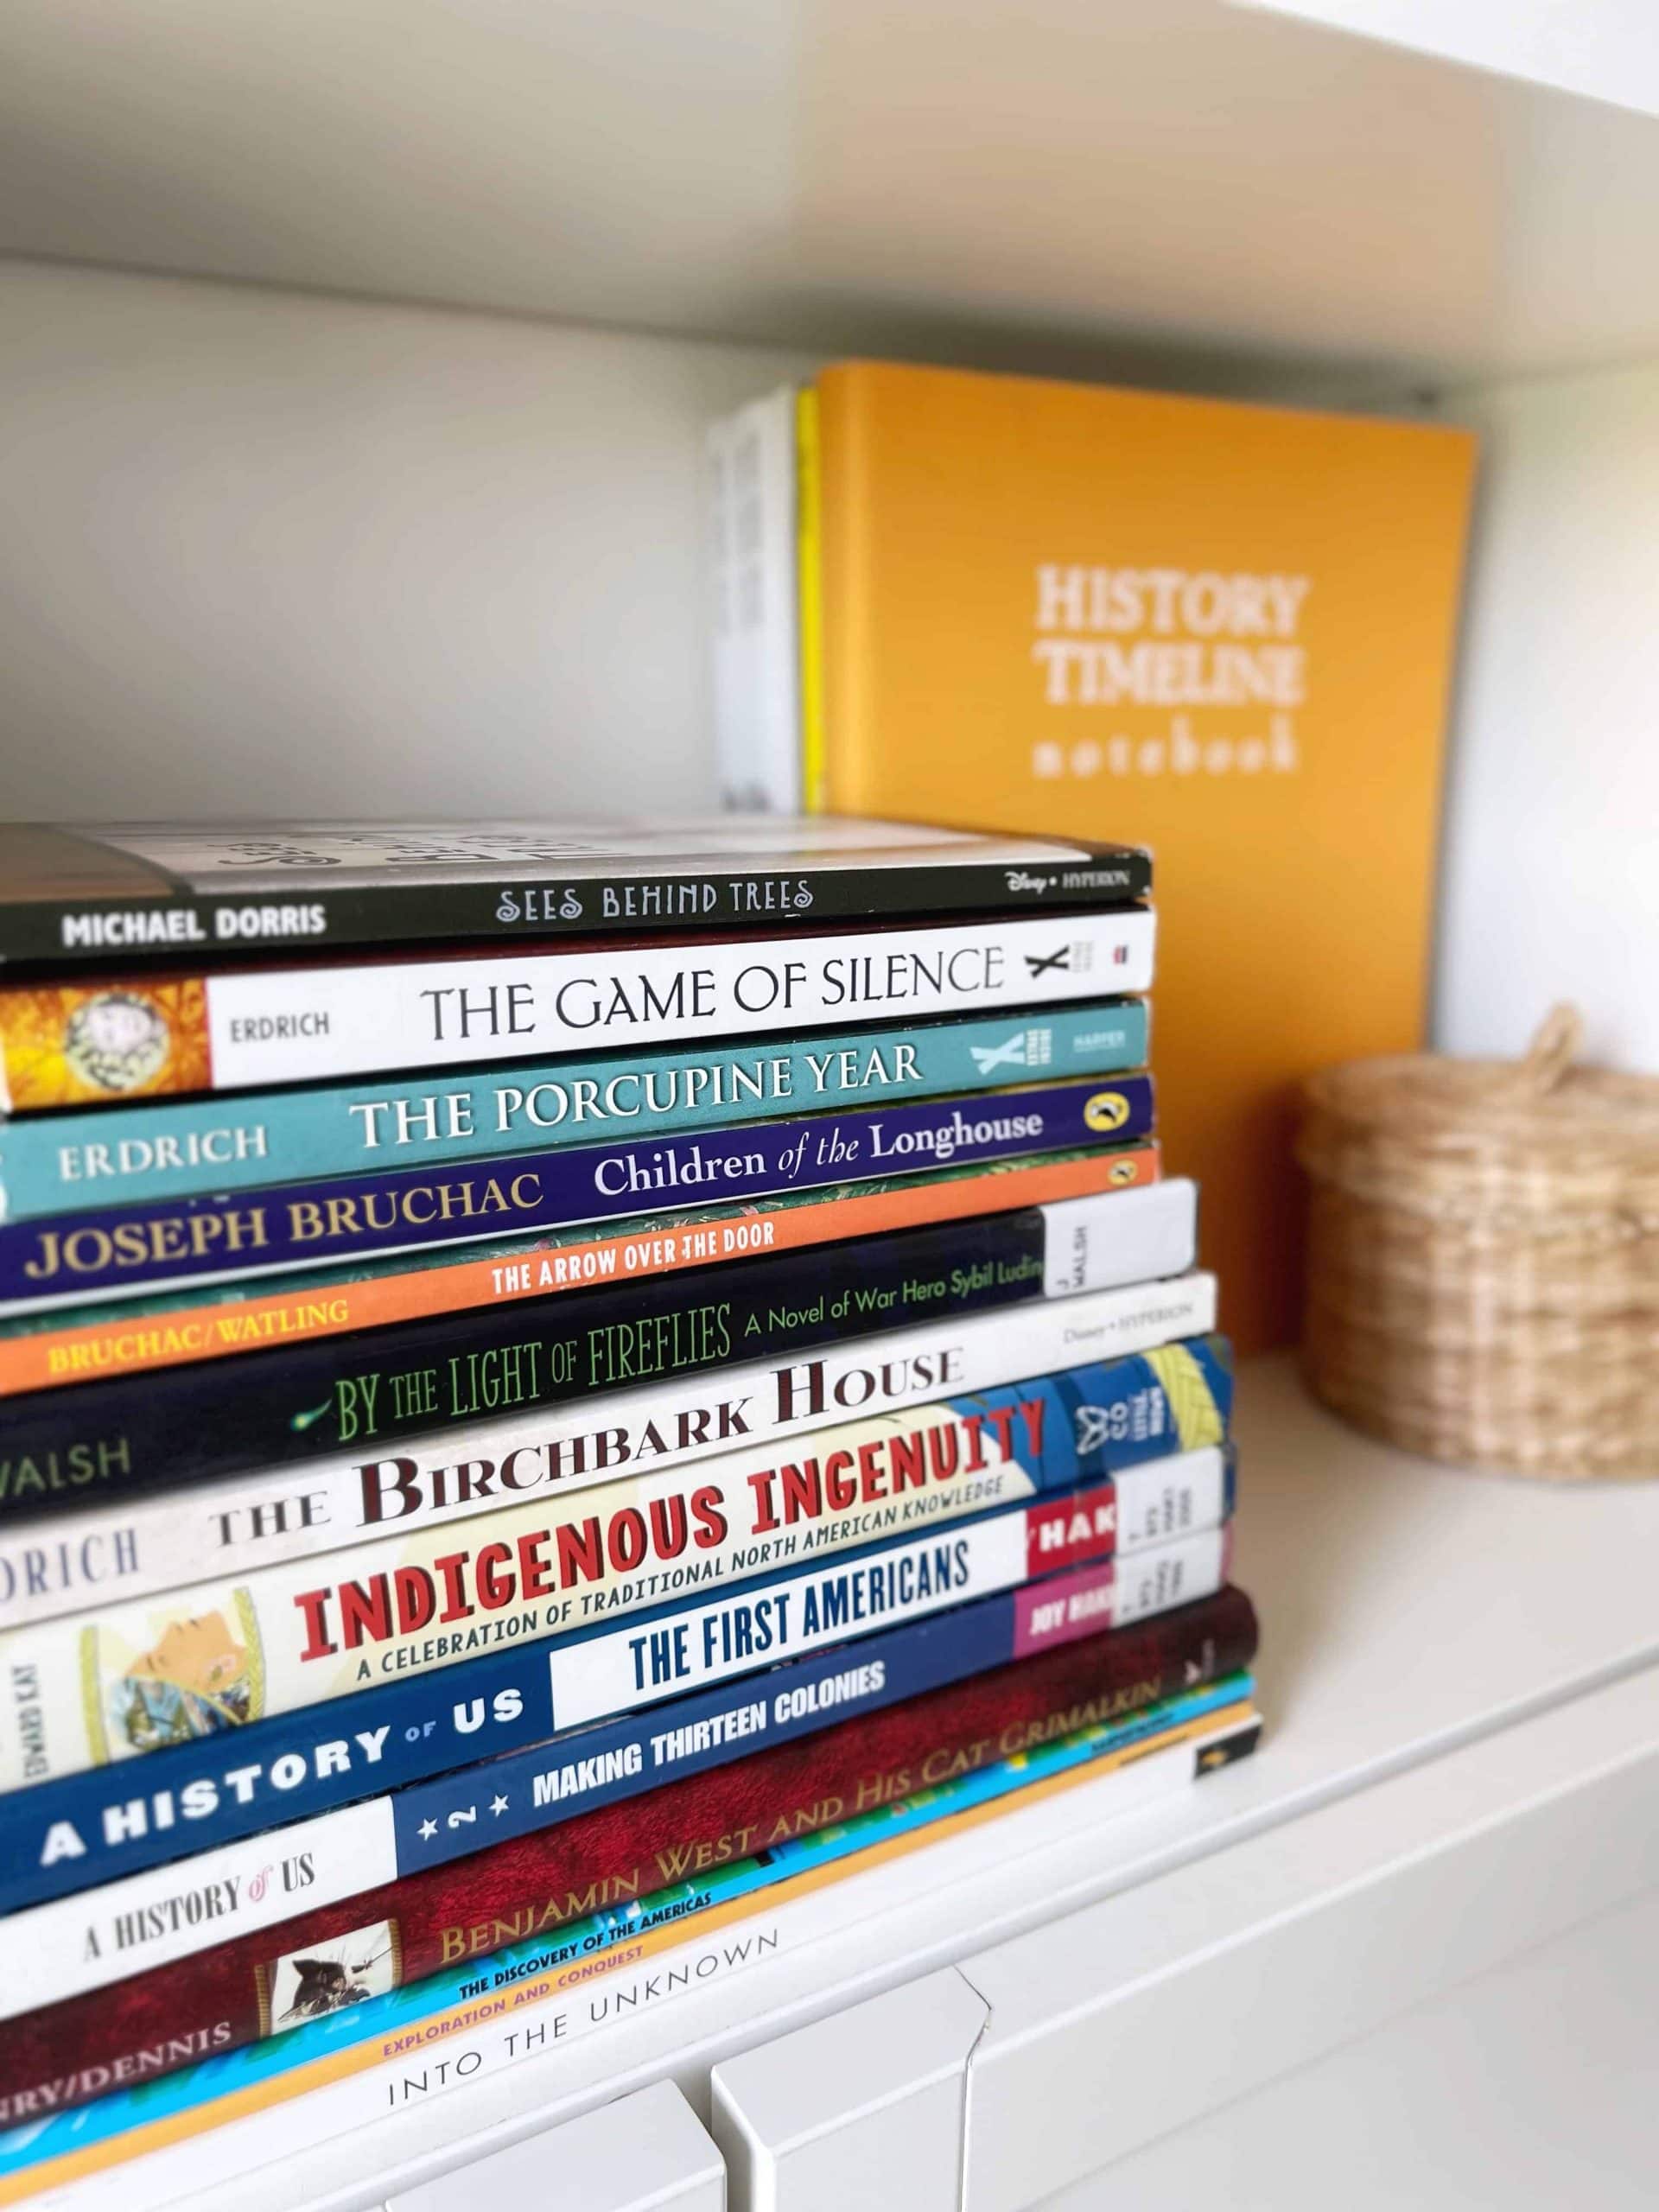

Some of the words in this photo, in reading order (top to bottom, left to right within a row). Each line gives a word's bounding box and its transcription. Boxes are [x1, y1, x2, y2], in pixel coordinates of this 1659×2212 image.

[1036, 563, 1313, 638] HISTORY
[1032, 640, 1308, 706] TIMELINE
[1032, 714, 1296, 779] notebook
[62, 911, 206, 947] MICHAEL
[216, 905, 327, 940] DORRIS
[496, 887, 582, 923] SEES
[602, 883, 717, 918] BEHIND
[730, 878, 814, 912] TREES
[230, 1011, 330, 1043] ERDRICH
[419, 982, 536, 1041] THE
[556, 969, 715, 1029] GAME
[734, 963, 809, 1013] OF
[823, 945, 1005, 1005] SILENCE
[348, 1092, 474, 1149] THE
[493, 1057, 792, 1133] PORCUPINE
[804, 1043, 925, 1094] YEAR
[58, 1124, 268, 1183] ERDRICH
[594, 1147, 766, 1196] Children
[779, 1133, 808, 1179] of
[816, 1126, 860, 1166] the
[868, 1111, 1043, 1159] Longhouse
[24, 1208, 268, 1281] JOSEPH
[287, 1173, 543, 1243] BRUCHAC
[493, 1268, 532, 1294] THE
[539, 1247, 616, 1286] ARROW
[624, 1235, 677, 1267] OVER
[682, 1231, 717, 1261] THE
[723, 1221, 775, 1252] DOOR
[48, 1300, 349, 1375] BRUCHAC/WATLING
[744, 1312, 763, 1338] A
[768, 1304, 825, 1332] Novel
[831, 1296, 852, 1319] of
[855, 1288, 898, 1313] War
[903, 1279, 945, 1303] Hero
[951, 1262, 994, 1297] Sybil
[336, 1373, 380, 1442] BY
[394, 1370, 437, 1419] THE
[448, 1341, 542, 1416] LIGHT
[551, 1340, 577, 1384] OF
[587, 1302, 732, 1389] FIREFLIES
[209, 1490, 333, 1548] THE
[352, 1395, 753, 1528] BIRCHBARK
[769, 1345, 965, 1424] HOUSE
[294, 1488, 728, 1663] INDIGENOUS
[747, 1398, 1046, 1535] INGENUITY
[355, 1658, 372, 1681] A
[381, 1616, 539, 1675] CELEBRATION
[545, 1604, 573, 1626] OF
[580, 1558, 723, 1618] TRADITIONAL
[731, 1537, 796, 1573] NORTH
[804, 1511, 898, 1556] AMERICAN
[903, 1475, 1004, 1522] KNOWLEDGE
[629, 1623, 690, 1692] THE
[702, 1593, 791, 1662] FIRST
[802, 1539, 969, 1616] AMERICANS
[1030, 1599, 1066, 1636] JOY
[40, 1821, 89, 1868] A
[101, 1726, 391, 1847] HISTORY
[404, 1720, 436, 1744] OF
[452, 1687, 525, 1734] US
[532, 1747, 642, 1808] MAKING
[650, 1708, 767, 1766] THIRTEEN
[774, 1660, 887, 1722] COLONIES
[441, 1868, 639, 1965] BENJAMIN
[654, 1825, 758, 1884] WEST
[771, 1795, 843, 1841] AND
[855, 1760, 912, 1811] HIS
[918, 1740, 989, 1783] CAT
[1000, 1675, 1162, 1754] GRIMALKIN
[448, 1805, 477, 1828] 2
[84, 1925, 104, 1964] A
[114, 1876, 243, 1952] HISTORY
[247, 1865, 275, 1902] of
[282, 1852, 316, 1893] US
[459, 1980, 490, 2001] THE
[493, 1944, 578, 1987] DISCOVERY
[582, 1934, 606, 1952] OF
[607, 1920, 637, 1941] THE
[639, 1891, 713, 1931] AMERICAS
[383, 1998, 506, 2057] EXPLORATION
[512, 1980, 550, 2006] AND
[557, 1944, 645, 1988] CONQUEST
[389, 2050, 483, 2106] INTO
[504, 2012, 568, 2058] THE
[589, 1928, 779, 2022] UNKNOWN
